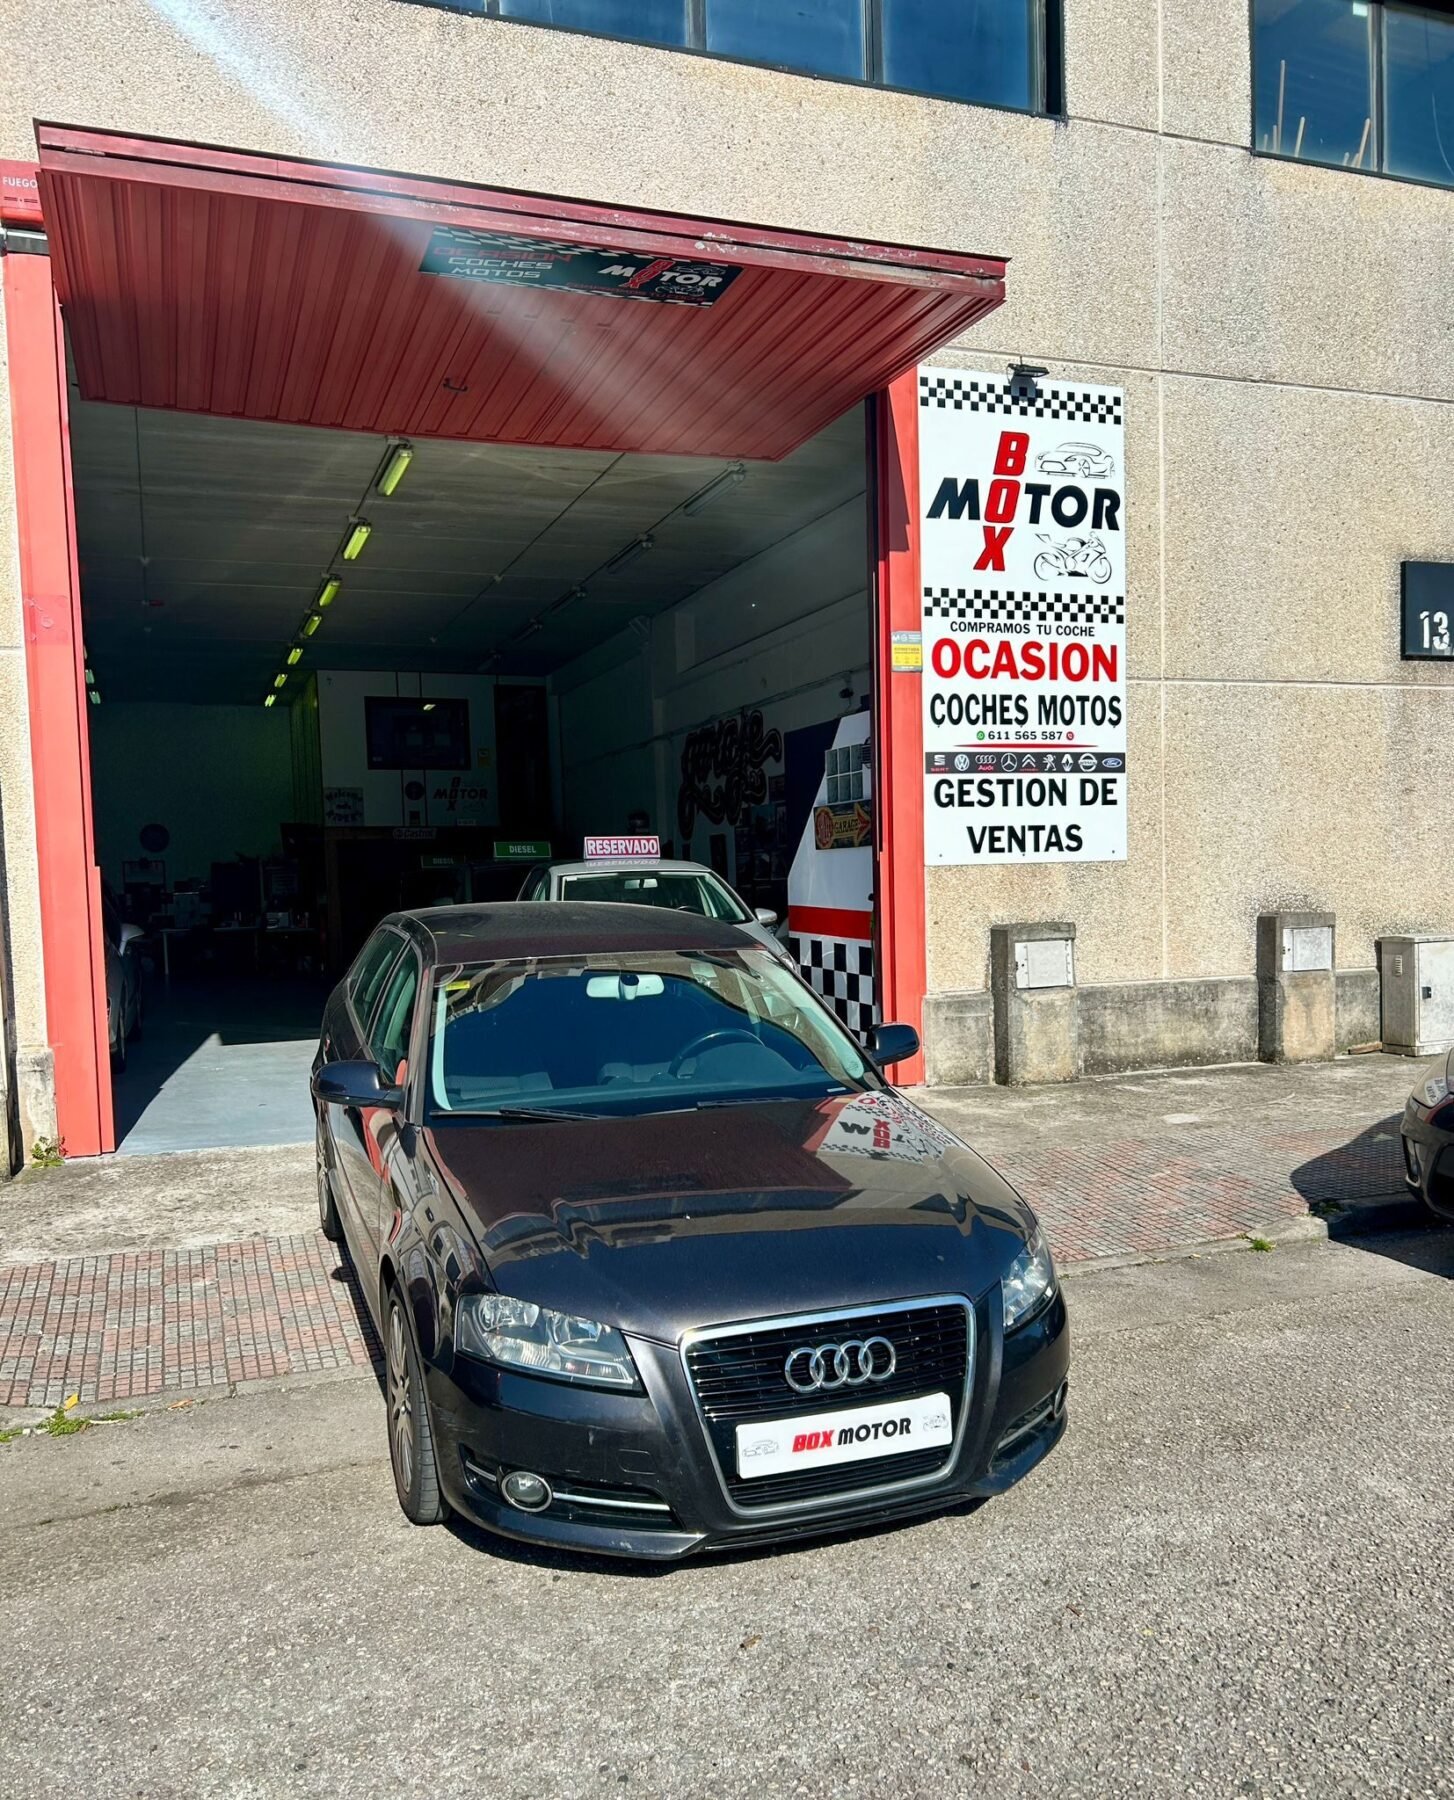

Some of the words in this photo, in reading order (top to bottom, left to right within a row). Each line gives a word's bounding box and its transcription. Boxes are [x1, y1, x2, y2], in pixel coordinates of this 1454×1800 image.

[3, 176, 38, 189] FUEGO
[434, 247, 574, 263] OCASION
[448, 257, 553, 270] COCHES
[451, 267, 541, 279] MOTOS
[926, 477, 1121, 531] MOTOR
[973, 431, 1030, 571] BOX
[950, 621, 1031, 635] COMPRAMOS
[1037, 624, 1052, 636] TU
[1056, 624, 1095, 637] COCHE
[1419, 611, 1450, 650] 13
[931, 638, 1118, 683] OCASION
[930, 693, 1029, 726] COCHES
[1038, 694, 1122, 726] MOTOS
[988, 731, 1010, 740] 611
[1015, 731, 1037, 740] 565
[1041, 731, 1063, 740] 587
[934, 778, 1067, 808] GESTION
[1080, 778, 1118, 806] DE
[508, 845, 537, 854] DIESEL
[587, 839, 657, 855] RESERVADO
[966, 824, 1083, 854] VENTAS
[792, 1430, 834, 1453] BOX
[838, 1417, 911, 1446] MOTOR
